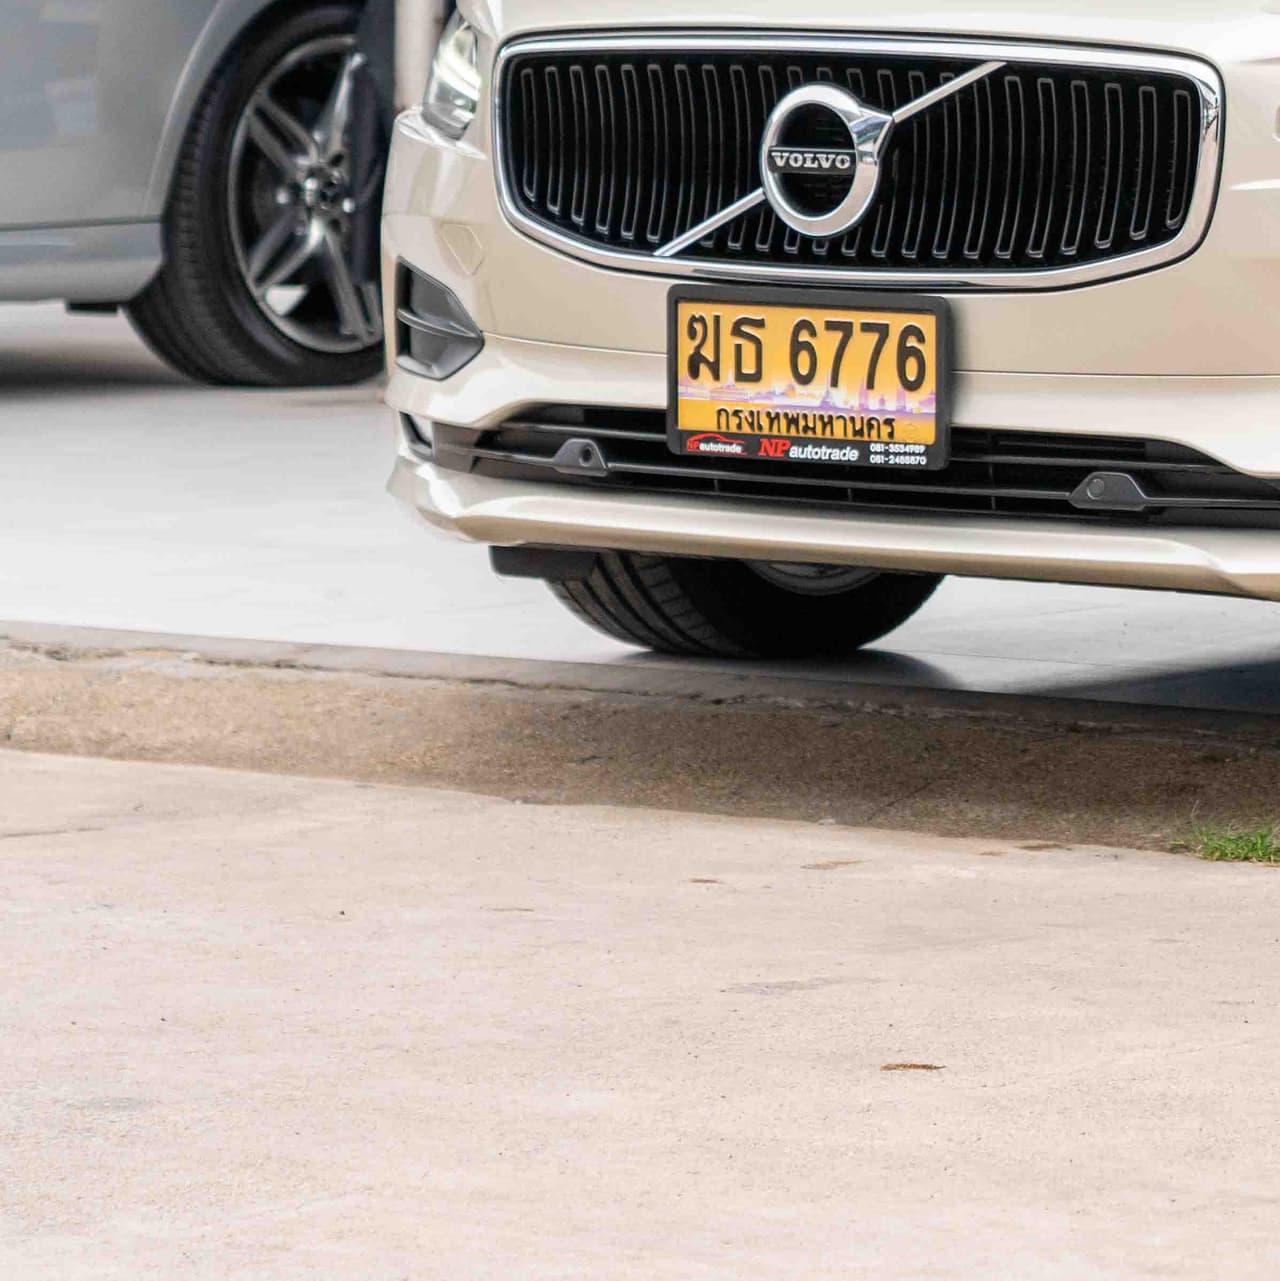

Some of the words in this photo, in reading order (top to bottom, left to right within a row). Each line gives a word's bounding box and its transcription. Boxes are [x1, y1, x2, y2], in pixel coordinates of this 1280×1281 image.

[771, 152, 851, 169] VOLVO
[687, 313, 766, 384] ฆธ
[789, 320, 927, 392] 6776
[716, 408, 896, 439] กรงเทพมหานคร
[758, 438, 791, 458] NP
[789, 444, 859, 462] autotrade
